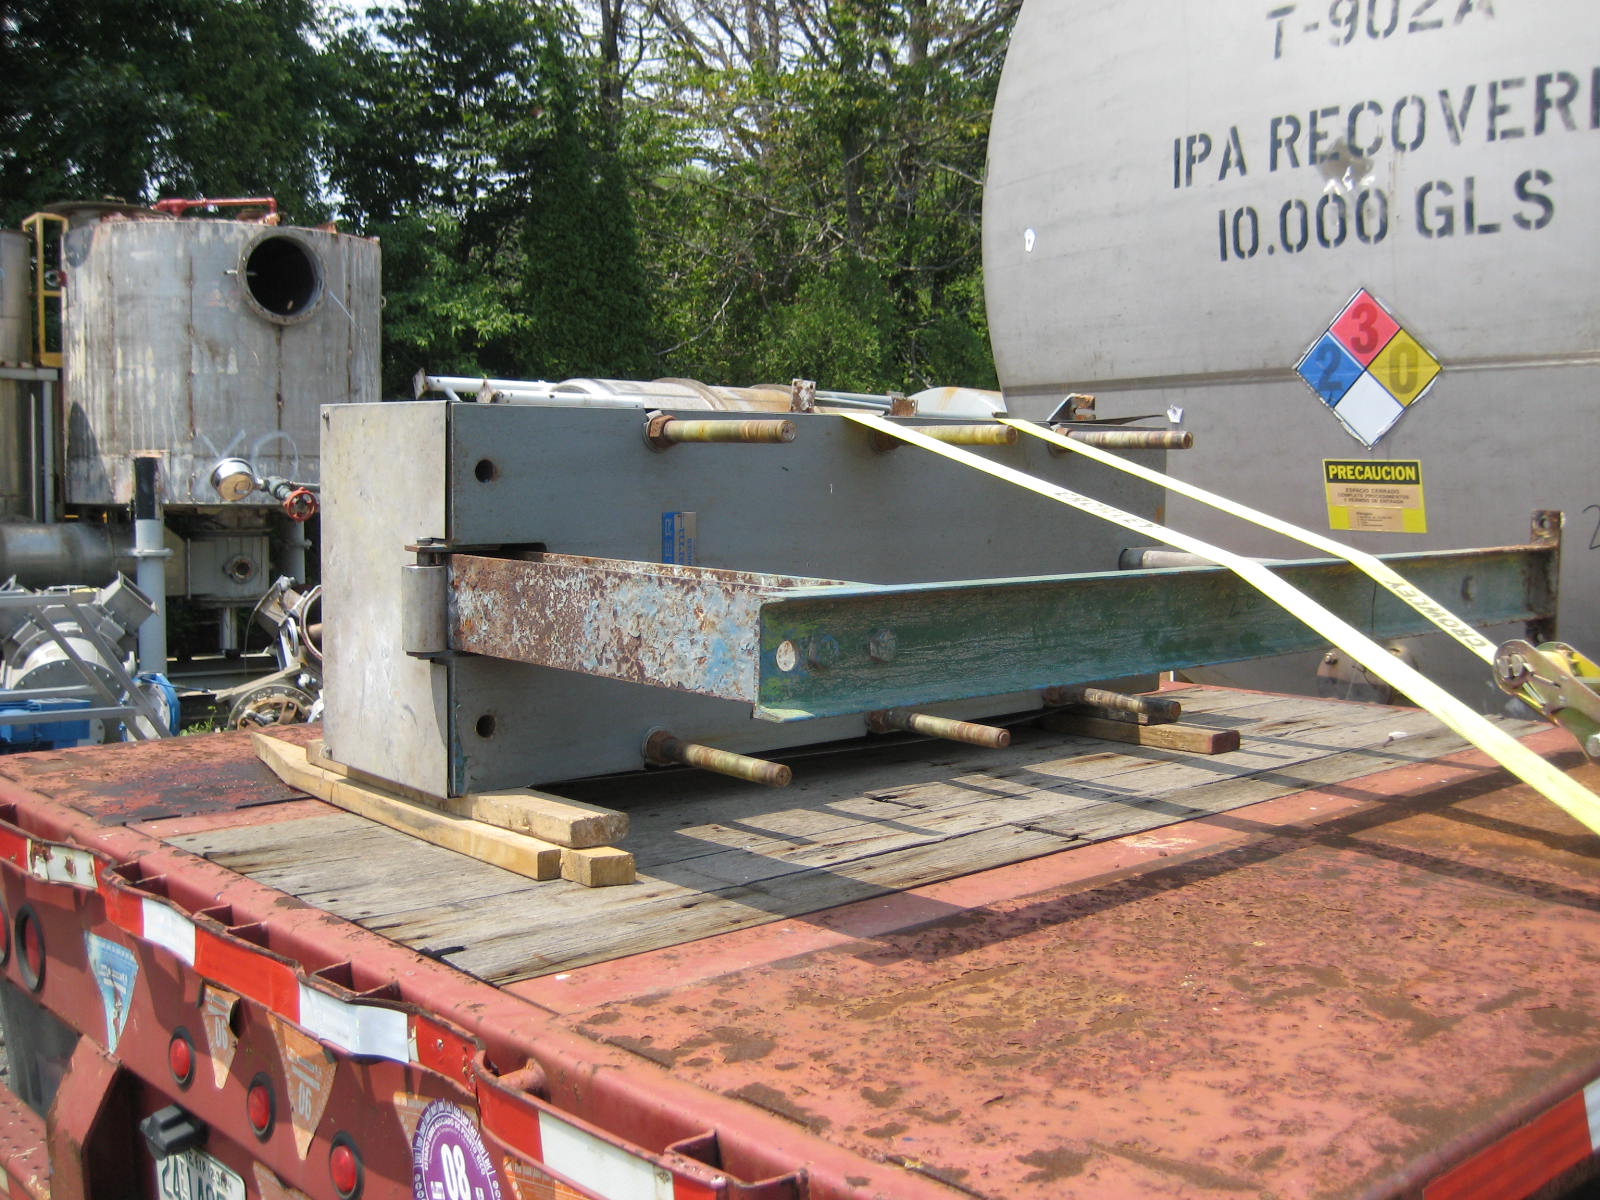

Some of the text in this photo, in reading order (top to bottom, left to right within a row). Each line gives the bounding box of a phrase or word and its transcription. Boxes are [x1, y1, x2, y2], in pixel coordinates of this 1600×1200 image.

[1173, 66, 1600, 189] IPA RECOVER
[1415, 168, 1555, 240] GLS
[1351, 302, 1379, 355] 3
[1315, 343, 1344, 392] 2
[1388, 342, 1418, 395] 0
[1328, 464, 1416, 481] PRECAUCION
[1382, 579, 1487, 650] CROWLEY
[440, 1143, 472, 1200] 08
